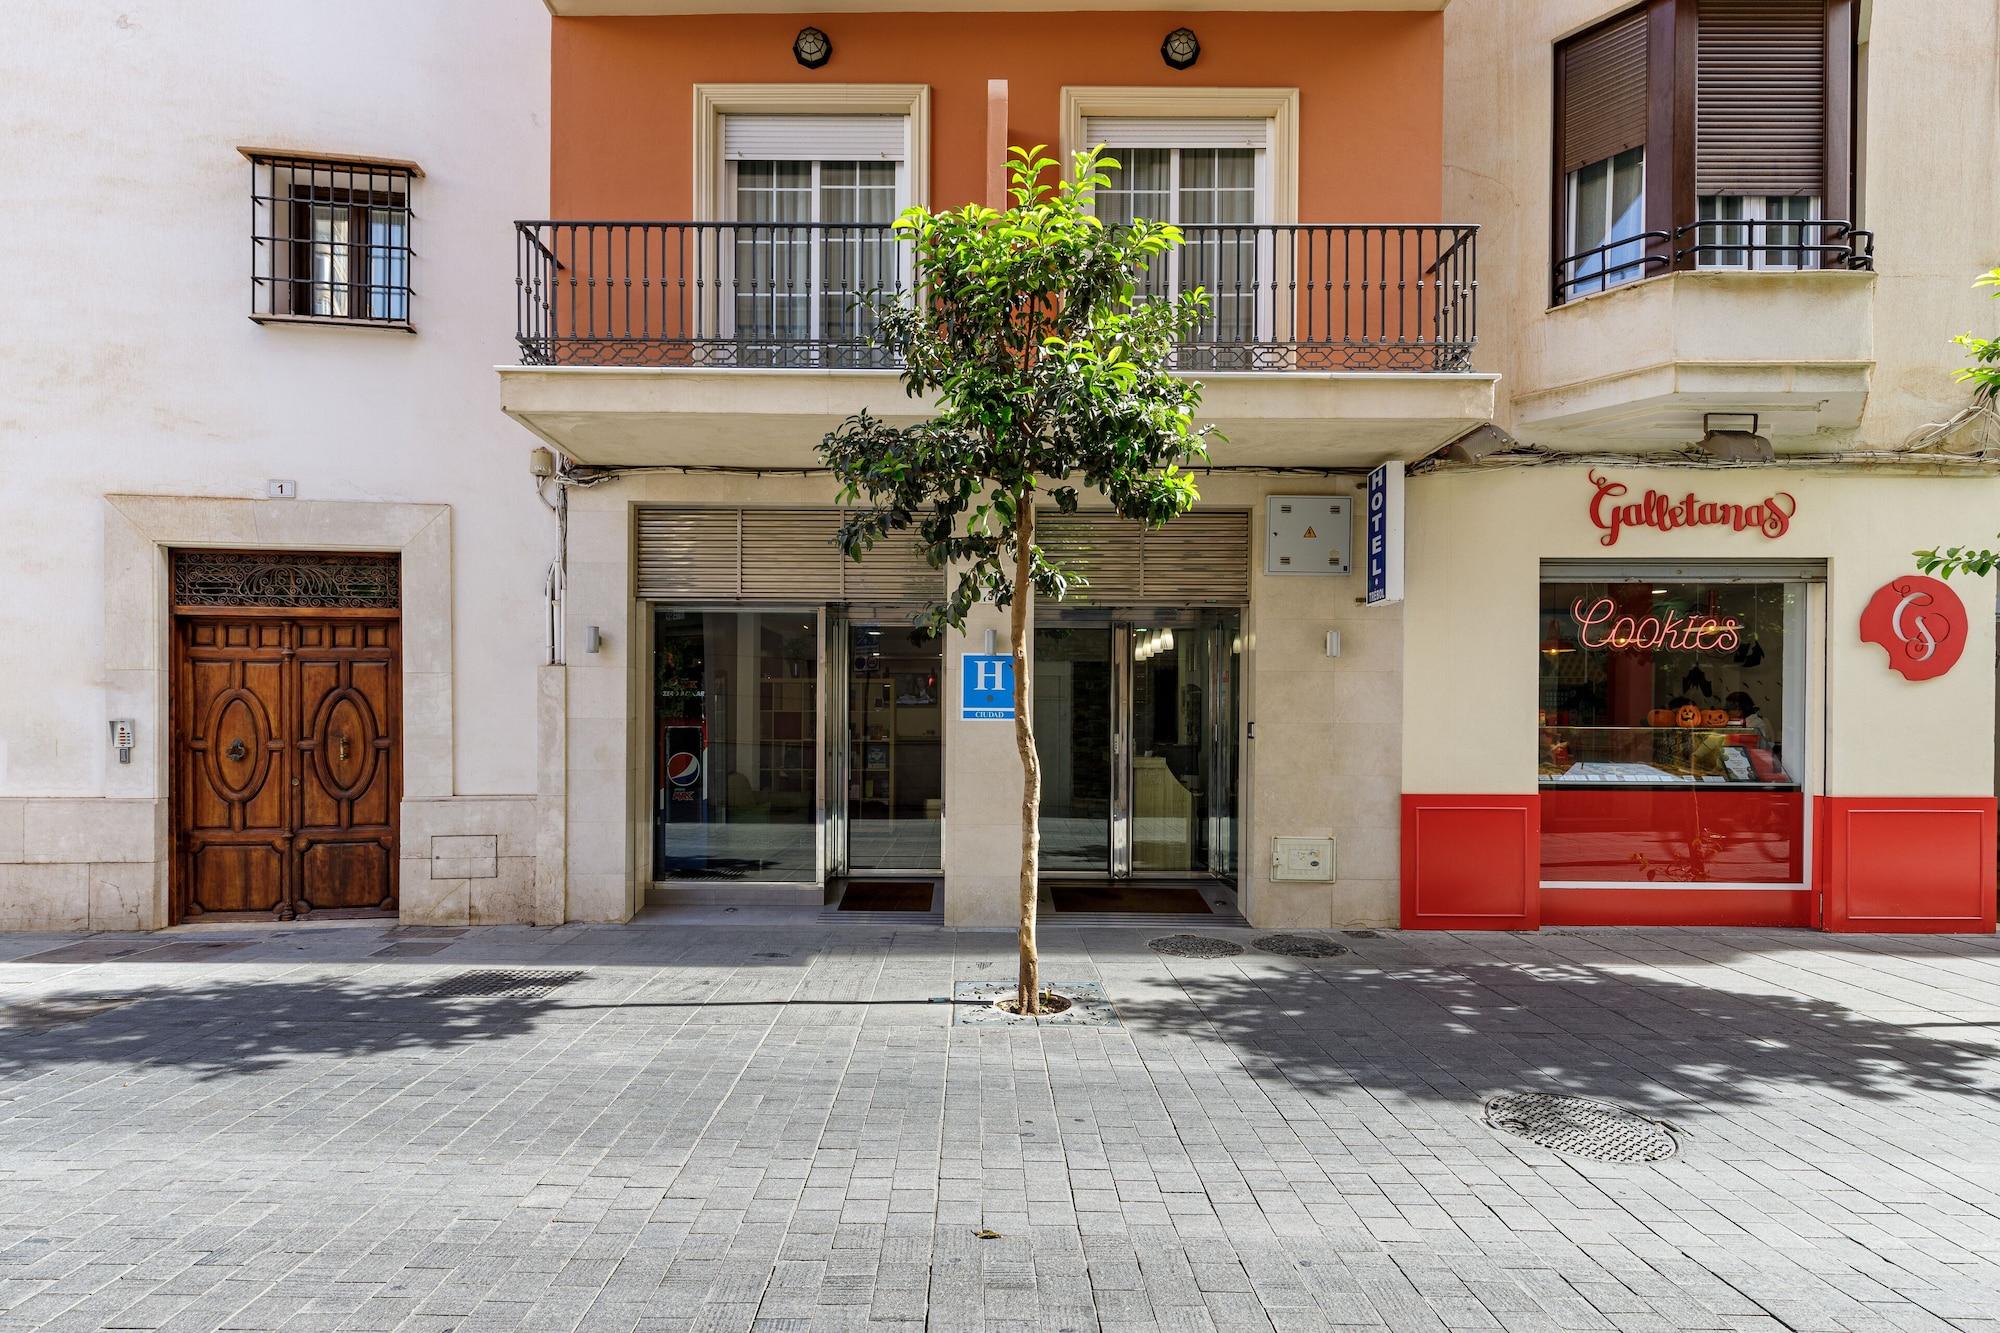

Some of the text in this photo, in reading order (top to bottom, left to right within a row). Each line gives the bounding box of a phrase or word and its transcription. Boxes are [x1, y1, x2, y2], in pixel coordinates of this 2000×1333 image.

[277, 483, 284, 495] 1
[1589, 468, 1796, 546] Galletanas
[1371, 469, 1383, 577] HOTEL
[1574, 598, 1740, 651] Cookies
[973, 660, 1007, 691] H
